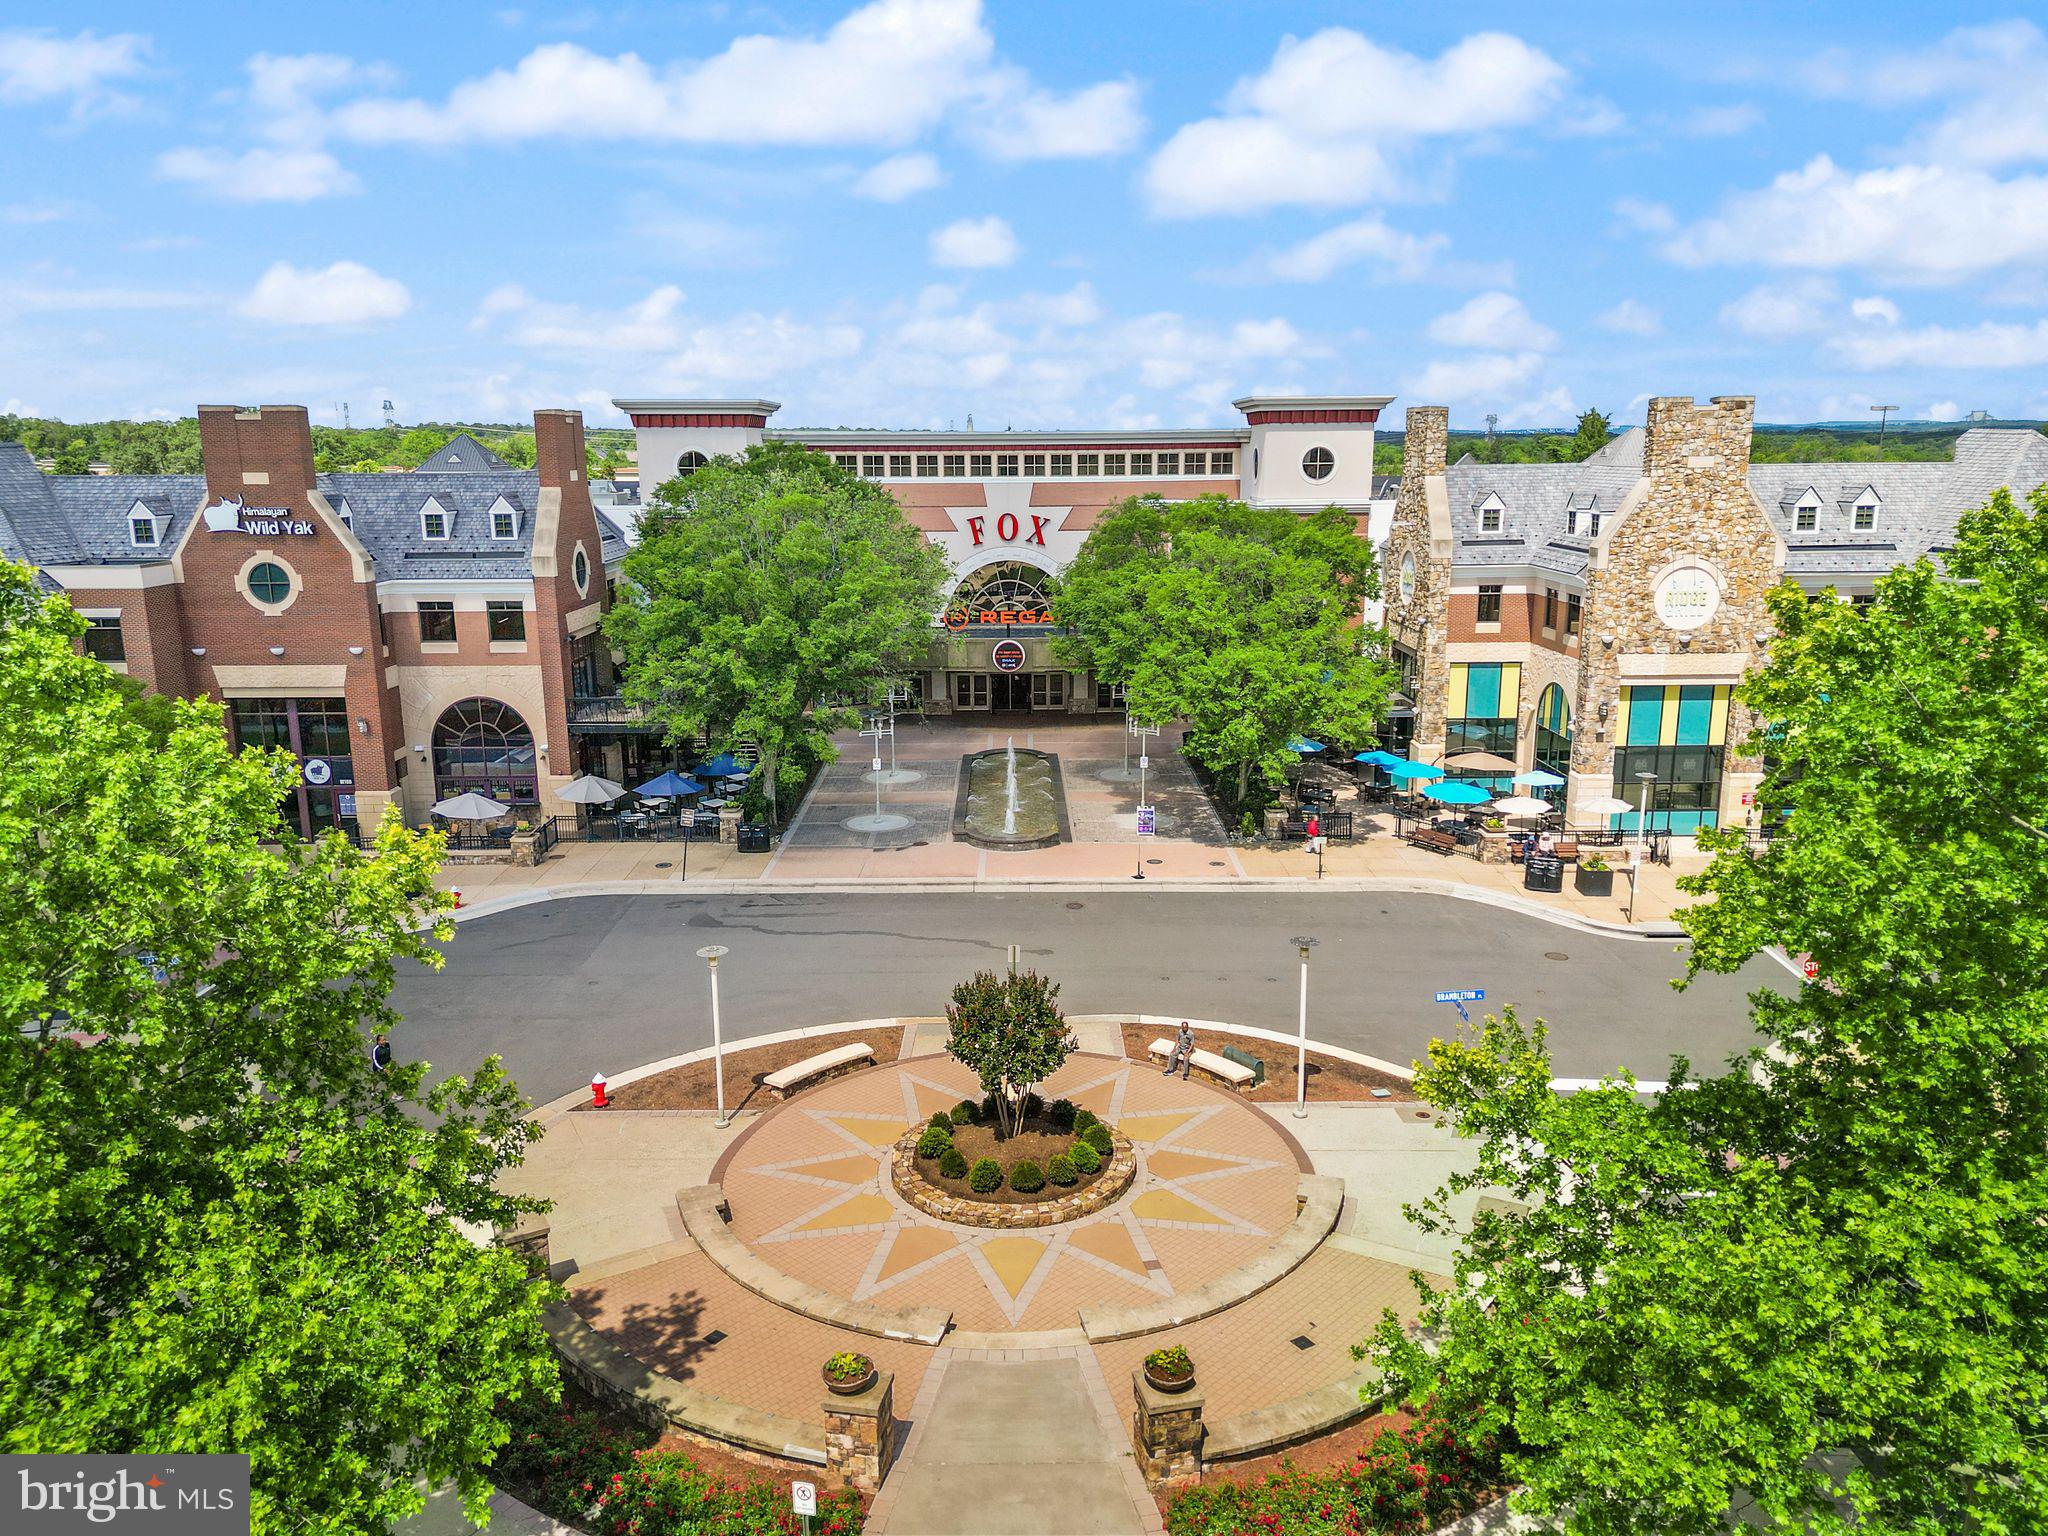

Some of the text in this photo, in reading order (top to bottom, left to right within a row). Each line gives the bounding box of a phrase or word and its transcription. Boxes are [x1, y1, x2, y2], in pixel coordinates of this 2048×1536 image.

[242, 507, 289, 518] Himalayan
[245, 521, 314, 535] Wild Yak
[966, 512, 1051, 546] FOX
[980, 611, 1058, 624] REGA
[1436, 991, 1476, 1001] BRAMBLETON
